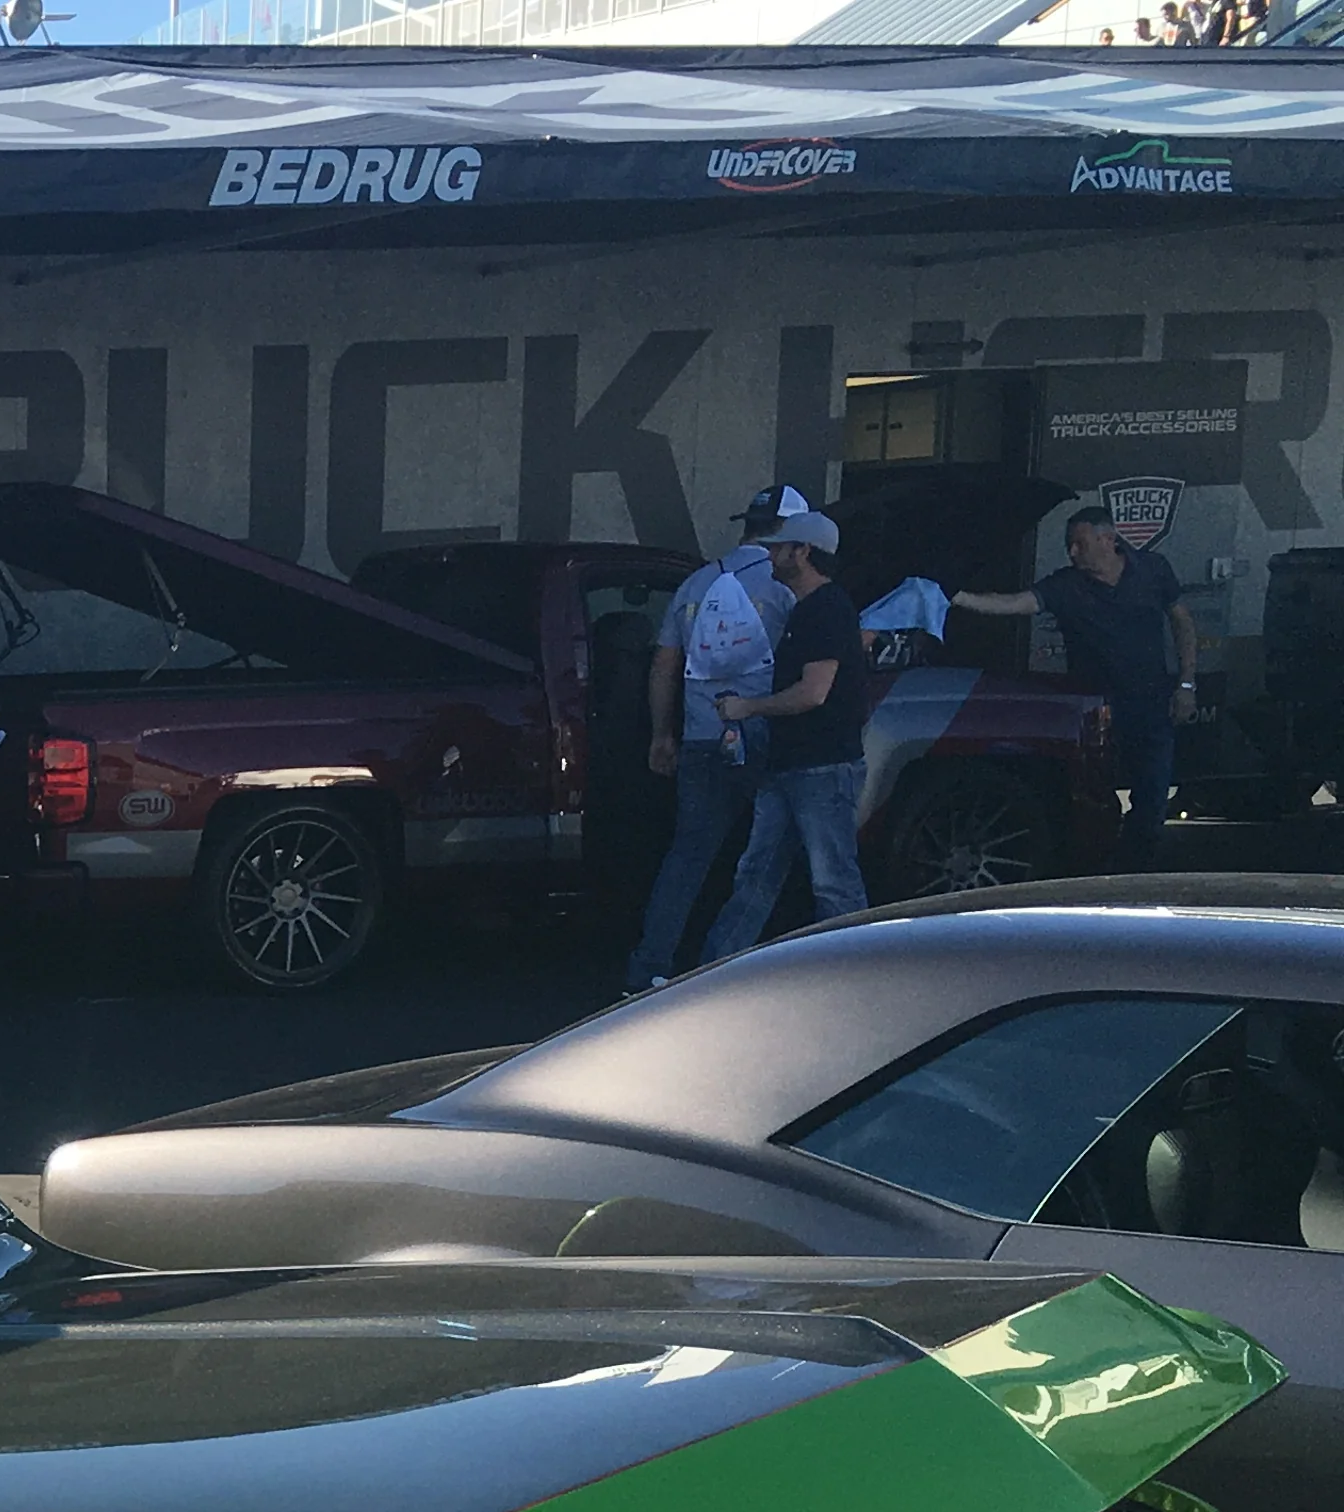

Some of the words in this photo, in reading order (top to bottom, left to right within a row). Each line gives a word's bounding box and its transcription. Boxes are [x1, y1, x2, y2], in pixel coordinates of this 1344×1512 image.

[209, 146, 483, 206] BEDRUG
[1070, 156, 1233, 193] ADVANTAGE
[1050, 411, 1134, 425] AMERICA'S
[1135, 410, 1175, 423] BEST
[1176, 408, 1238, 421] SELLING
[1050, 422, 1111, 439] TRUCK
[1114, 419, 1238, 437] ACCESSORIES
[1112, 488, 1173, 506] TRUCK
[1116, 505, 1166, 523] HERO
